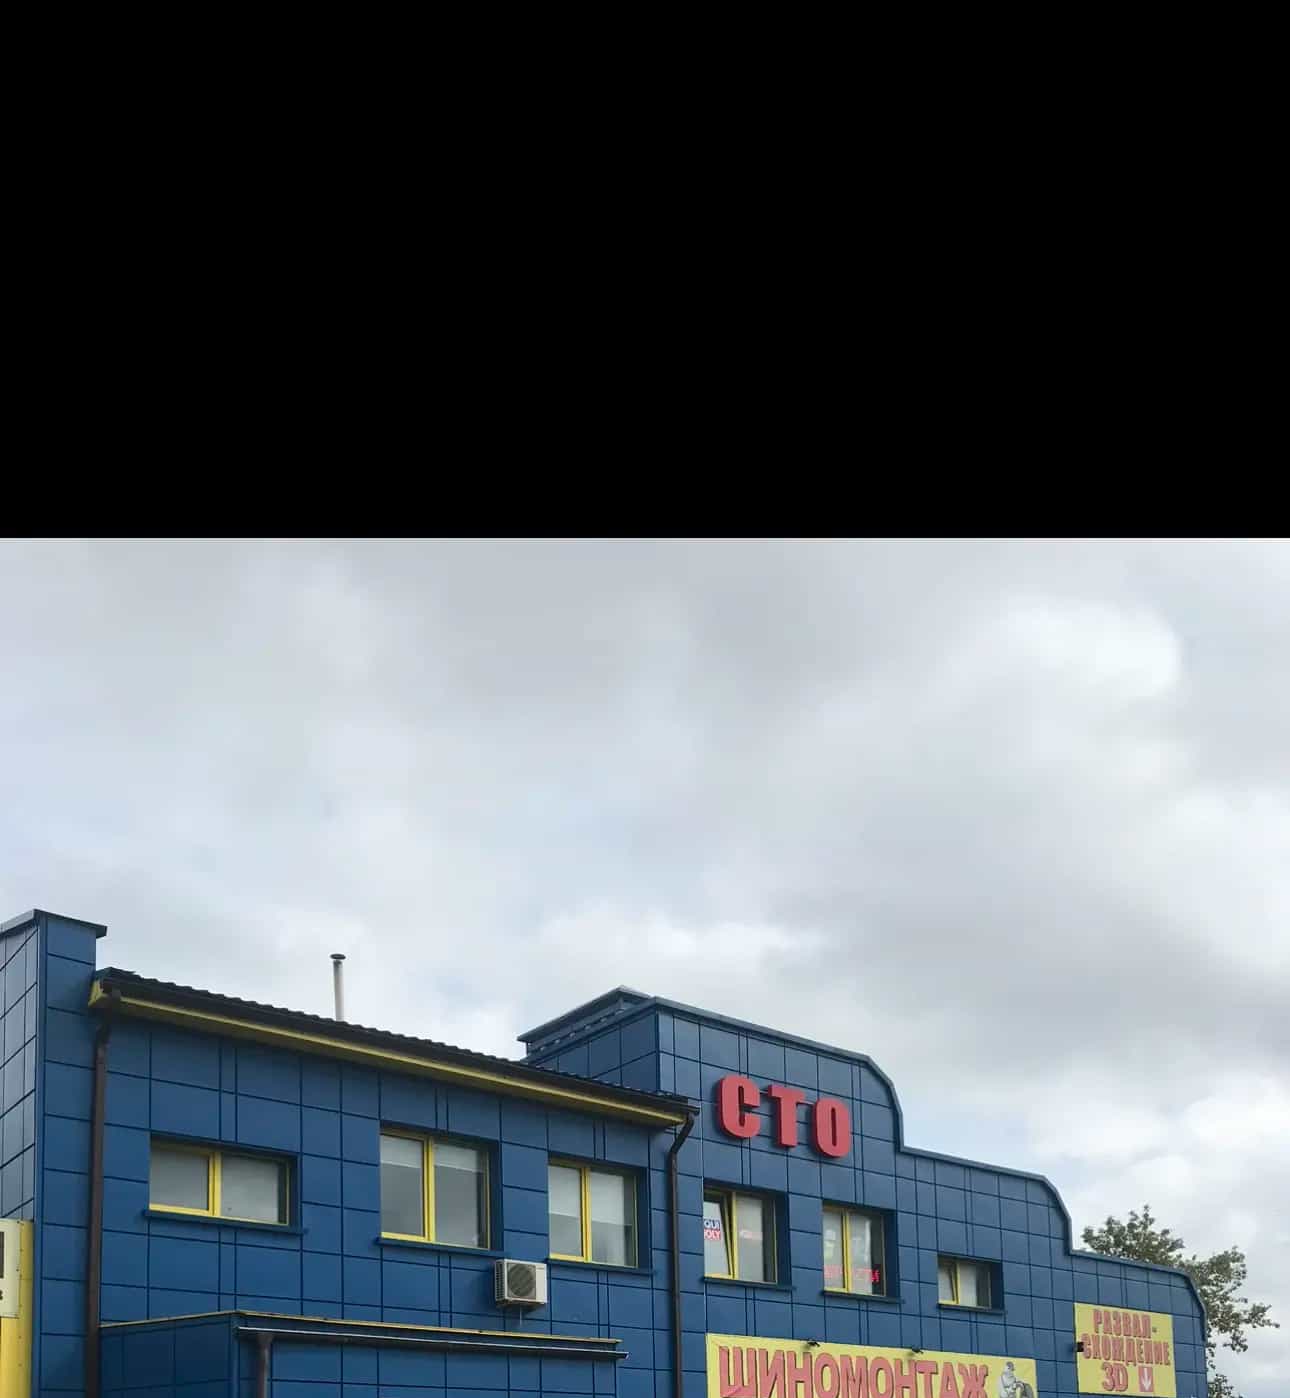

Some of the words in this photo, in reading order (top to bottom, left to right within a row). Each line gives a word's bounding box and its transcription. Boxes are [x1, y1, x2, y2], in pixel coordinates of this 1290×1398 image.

[718, 1074, 851, 1158] СТО
[1093, 1309, 1157, 1339] РАЗВАЛ-
[1081, 1333, 1170, 1366] СХОЖДЕНИЕ
[1102, 1362, 1128, 1392] 3D
